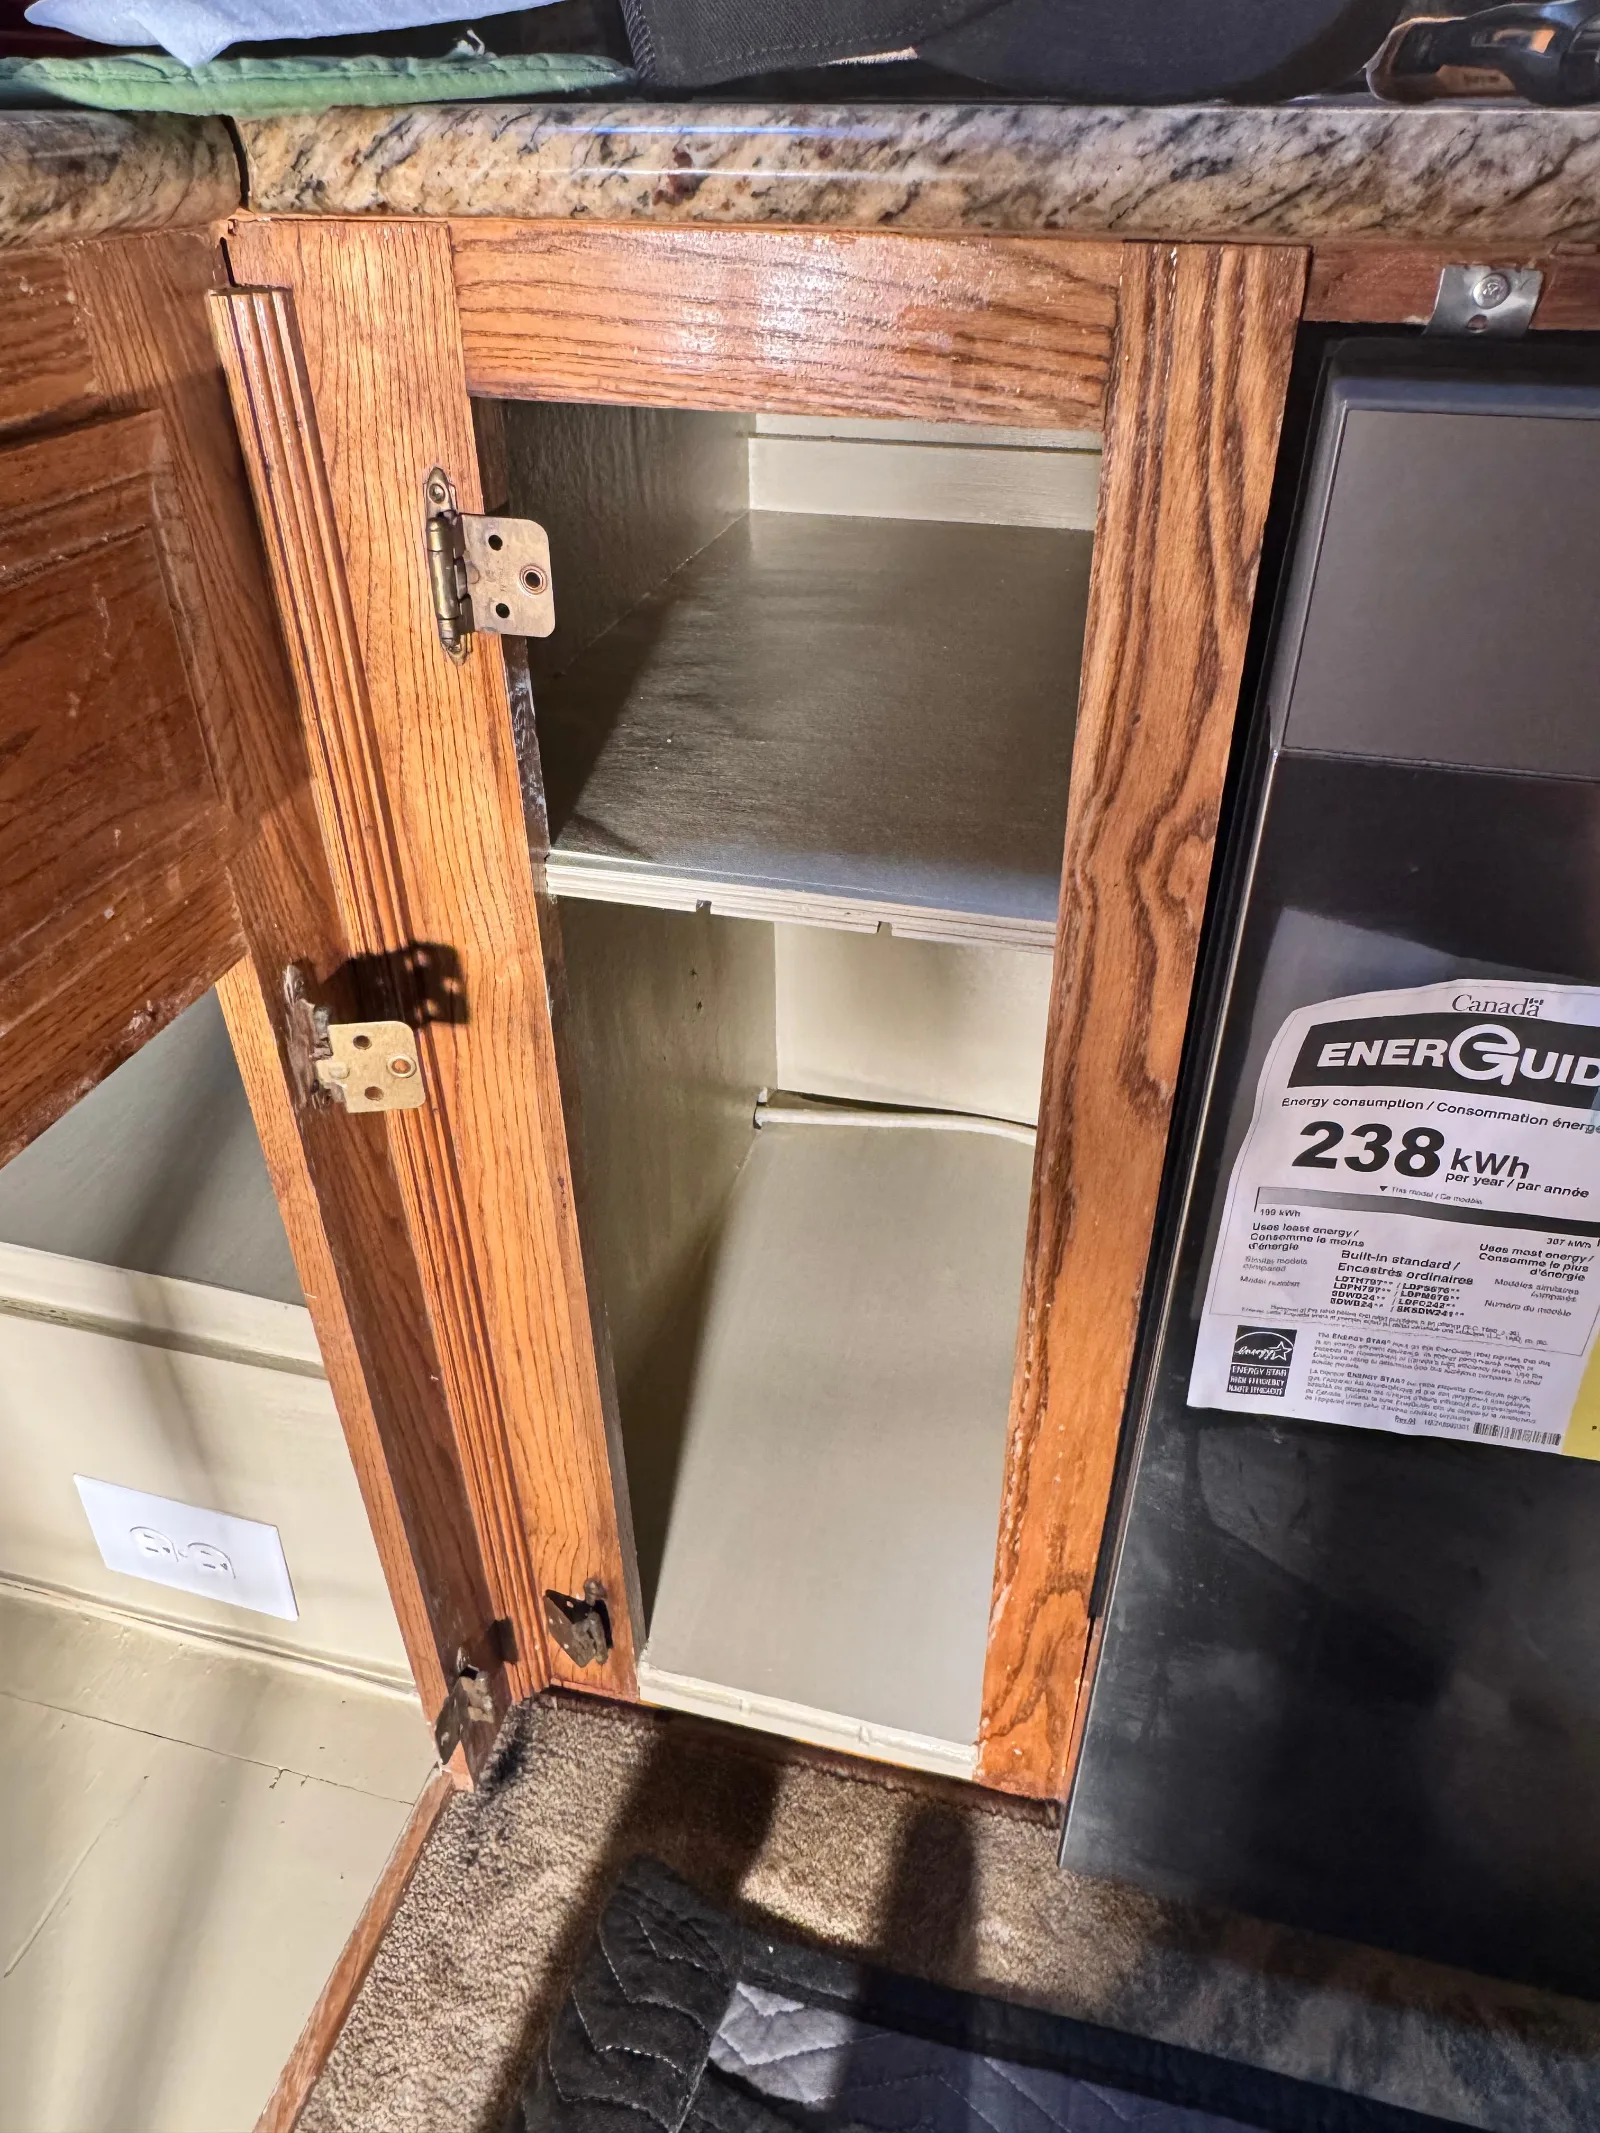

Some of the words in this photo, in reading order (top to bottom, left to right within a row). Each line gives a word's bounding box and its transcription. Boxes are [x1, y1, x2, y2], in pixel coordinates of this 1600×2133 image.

[1452, 993, 1541, 1017] Canada
[1281, 1097, 1329, 1108] Energy
[1332, 1097, 1424, 1110] consumption
[1426, 1101, 1435, 1111] /
[1436, 1101, 1549, 1127] Consommation
[1291, 1120, 1445, 1178] 238
[1450, 1147, 1530, 1180] kWh
[1445, 1172, 1469, 1183] per
[1473, 1175, 1505, 1187] year
[1506, 1178, 1515, 1188] /
[1515, 1181, 1541, 1192] par
[1543, 1184, 1590, 1199] année
[1278, 1208, 1301, 1218] kWh
[1250, 1232, 1314, 1243] Consomme
[1316, 1235, 1327, 1244] le
[1329, 1238, 1365, 1248] moins
[1252, 1222, 1280, 1232] Uses
[1282, 1223, 1310, 1233] least
[1312, 1227, 1353, 1238] energy
[1248, 1242, 1300, 1252] d'énergie
[1479, 1243, 1509, 1254] Uses
[1511, 1247, 1543, 1258] most
[1545, 1252, 1588, 1264] energy
[1341, 1249, 1388, 1263] Built-in
[1391, 1256, 1452, 1270] standard
[1478, 1252, 1547, 1268] Consomme
[1549, 1260, 1561, 1269] le
[1562, 1261, 1590, 1273] plus
[1337, 1262, 1403, 1278] Encastrés
[1405, 1270, 1474, 1286] ordinaires
[1529, 1268, 1586, 1282] d'énergie
